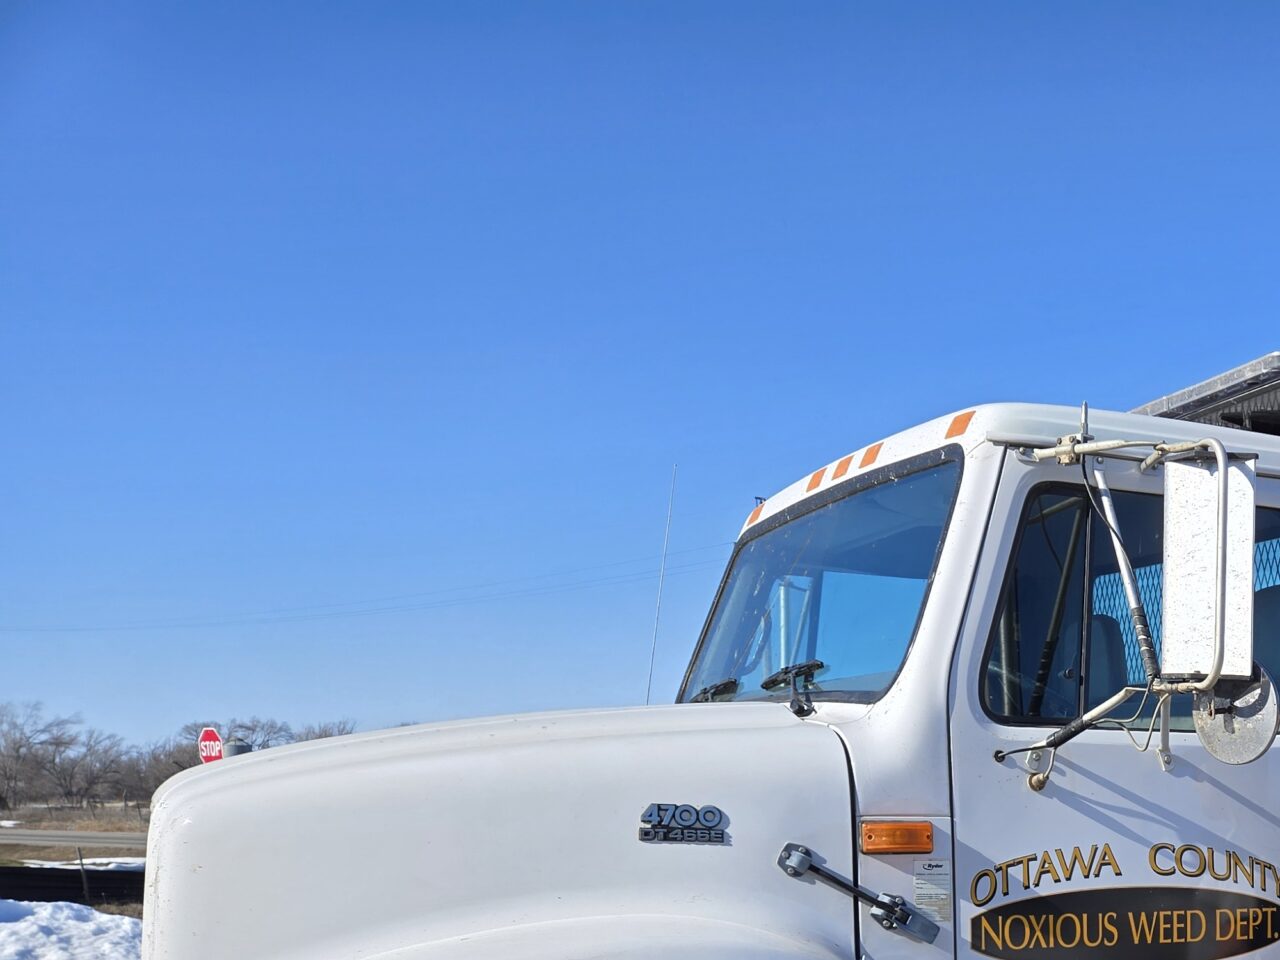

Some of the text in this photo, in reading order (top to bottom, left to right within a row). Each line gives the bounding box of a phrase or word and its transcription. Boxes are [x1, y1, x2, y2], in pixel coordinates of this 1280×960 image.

[200, 740, 221, 757] STOP
[640, 802, 722, 828] 4700
[970, 842, 1122, 907] OTTAWA
[981, 907, 1279, 951] NOXIOUS WEED DEPT.
